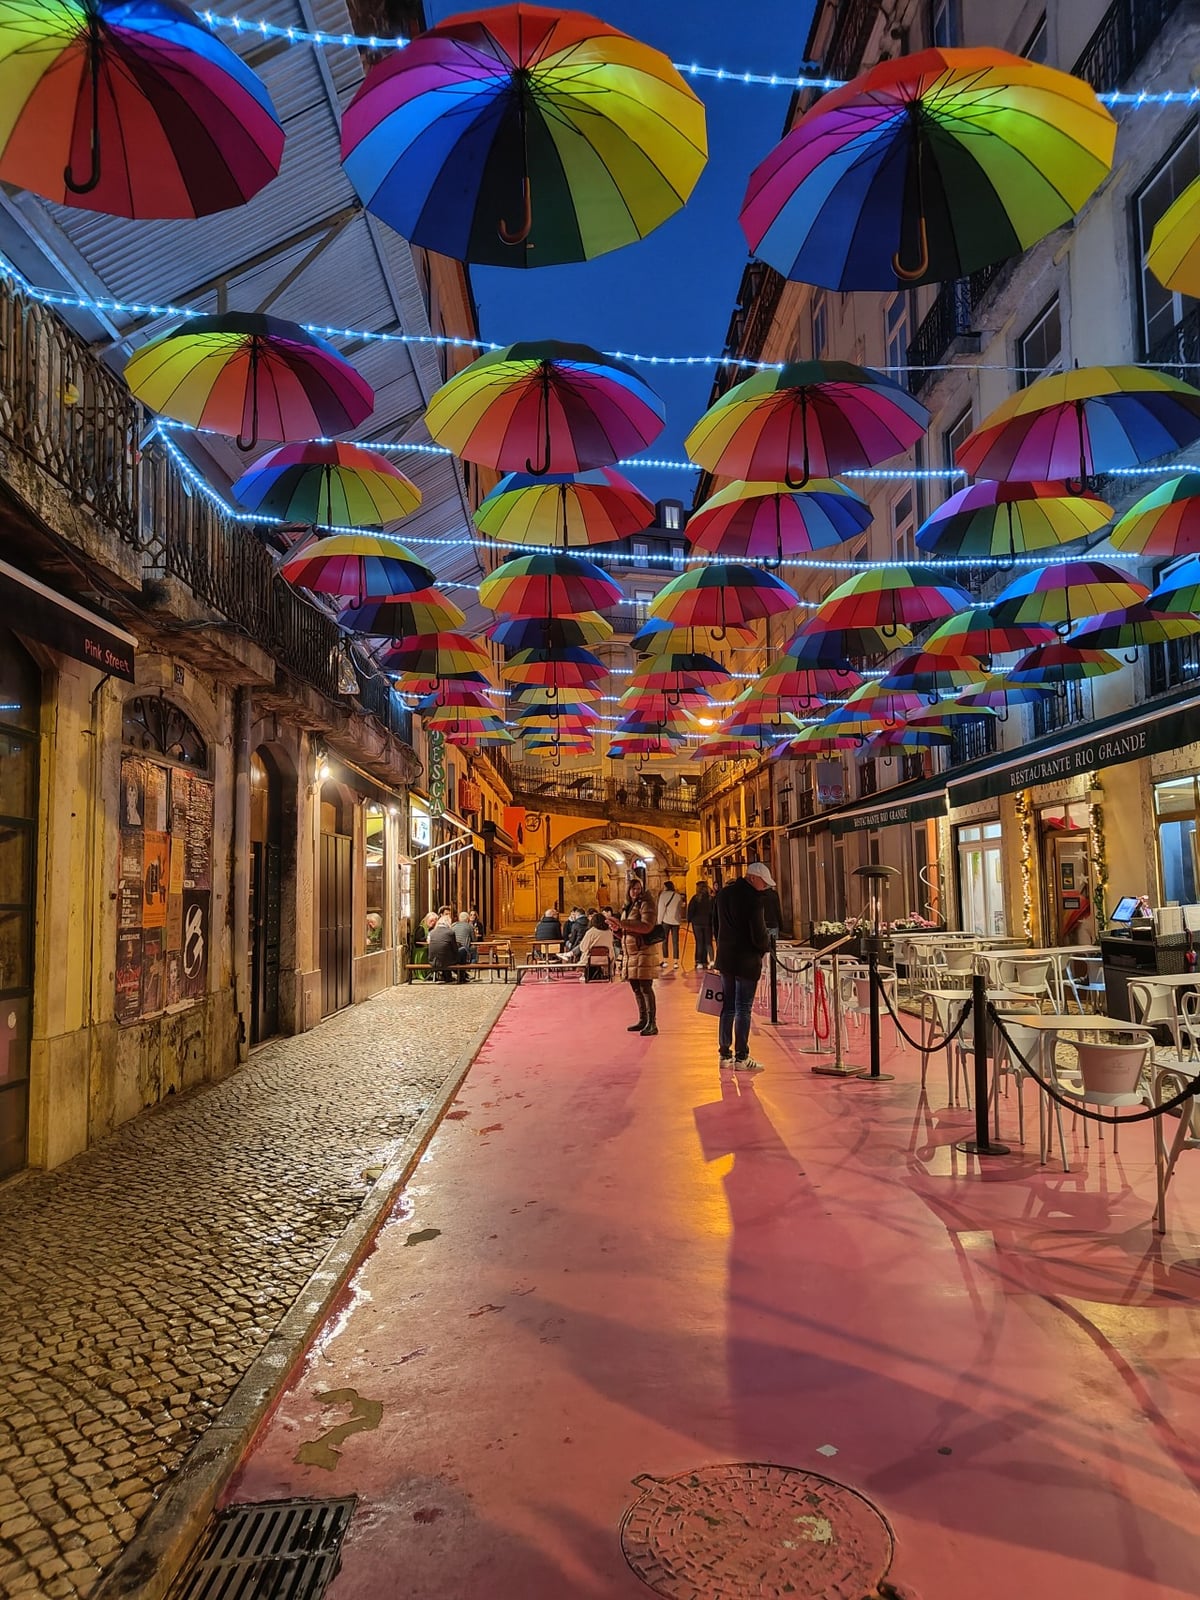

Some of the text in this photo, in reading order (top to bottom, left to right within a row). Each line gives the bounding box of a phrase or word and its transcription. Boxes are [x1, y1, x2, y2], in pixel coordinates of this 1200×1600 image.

[85, 639, 130, 673] Pink Street
[1009, 731, 1147, 786] RESTAURANTE RIO GRANDE
